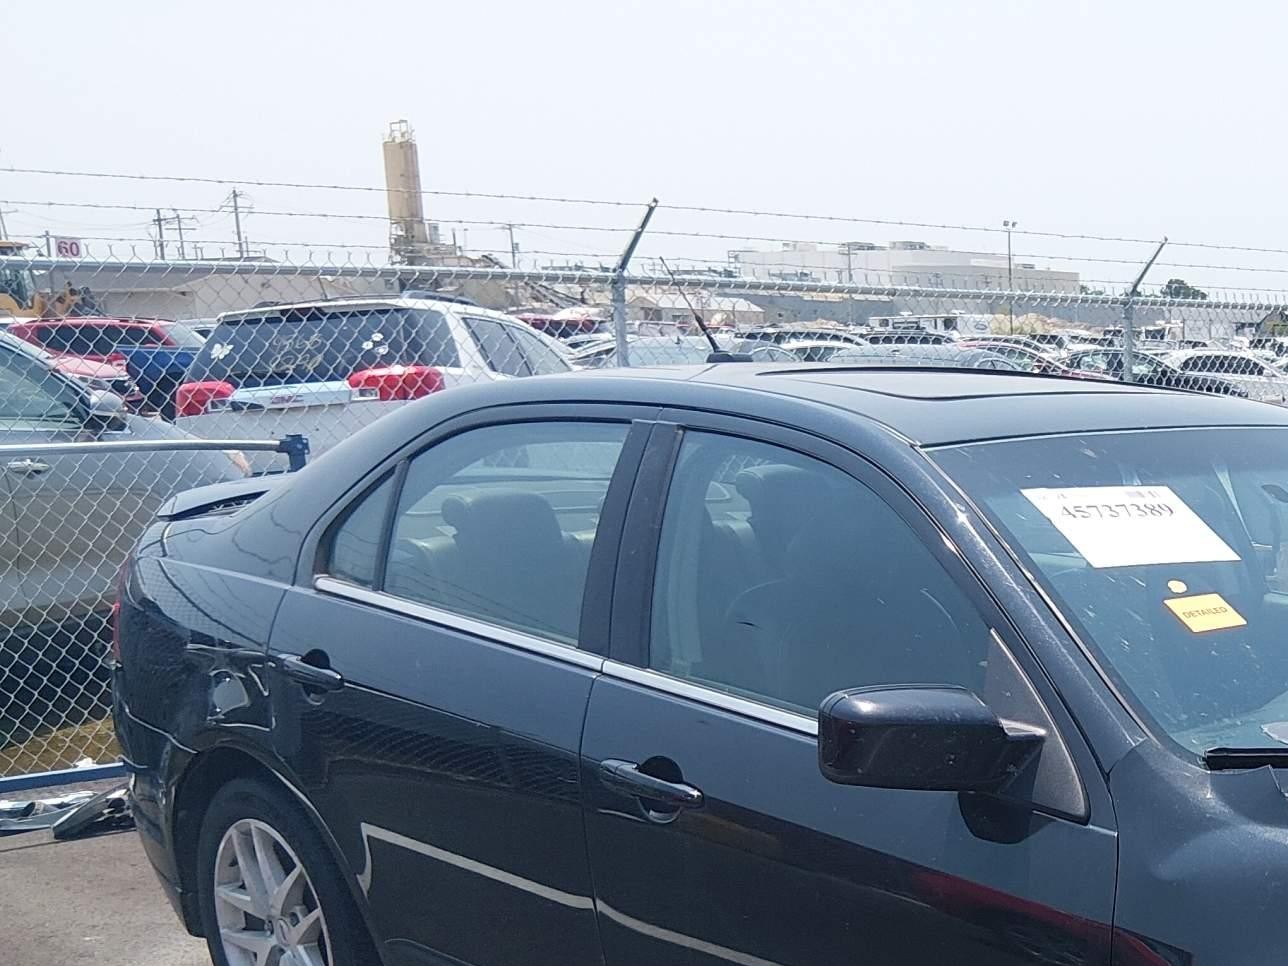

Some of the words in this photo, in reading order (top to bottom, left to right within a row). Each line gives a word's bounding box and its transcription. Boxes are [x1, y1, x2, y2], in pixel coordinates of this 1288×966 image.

[57, 240, 80, 257] 60
[1061, 503, 1175, 520] 45737389
[1182, 606, 1228, 619] DETAILED
